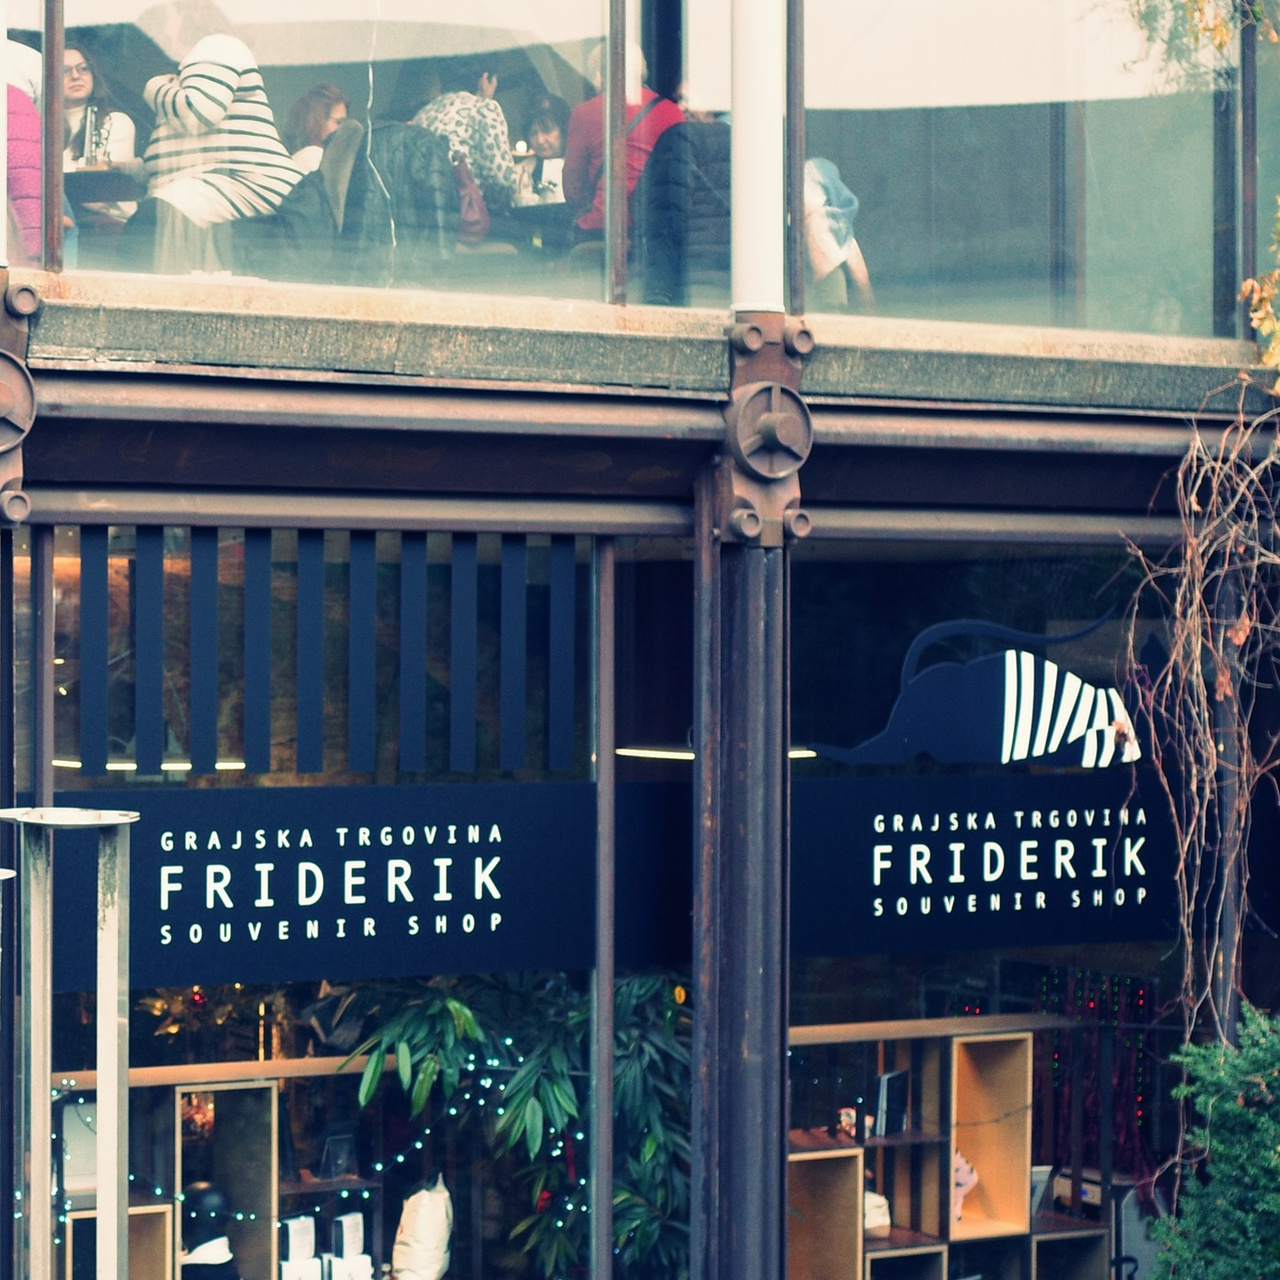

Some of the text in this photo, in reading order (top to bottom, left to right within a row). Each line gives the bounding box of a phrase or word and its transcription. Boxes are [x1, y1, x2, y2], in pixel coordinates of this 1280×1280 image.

[873, 808, 1147, 833] GRAJSKA TRGOVINA
[160, 823, 503, 852] GRAJSKA TRGOVINA
[873, 836, 1147, 886] FRIDERIK
[160, 856, 503, 911] FRIDERIK
[873, 887, 1147, 917] SOUVENIR SHOP
[160, 912, 503, 945] SOUVENIR SHOP
